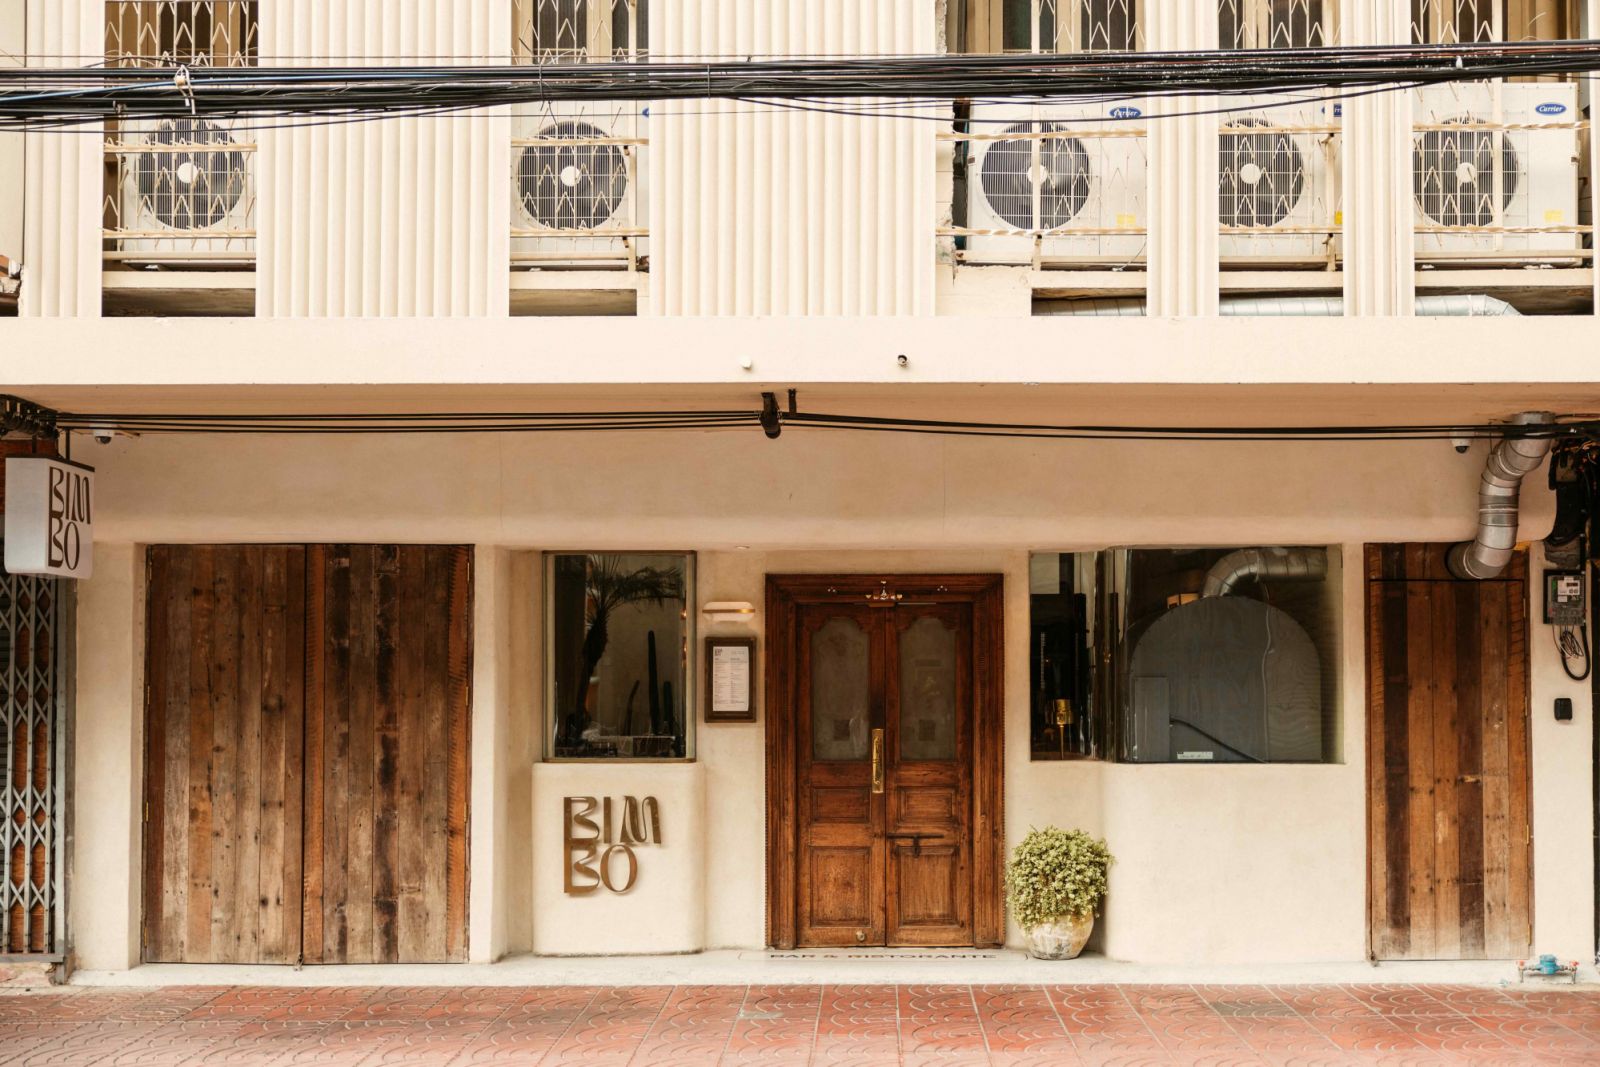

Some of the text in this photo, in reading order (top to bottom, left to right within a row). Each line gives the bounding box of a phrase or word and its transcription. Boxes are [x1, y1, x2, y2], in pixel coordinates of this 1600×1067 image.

[1539, 104, 1564, 113] Carrier
[49, 466, 91, 525] BIM
[48, 514, 80, 571] BO
[563, 796, 661, 844] BIM
[563, 840, 638, 893] BO
